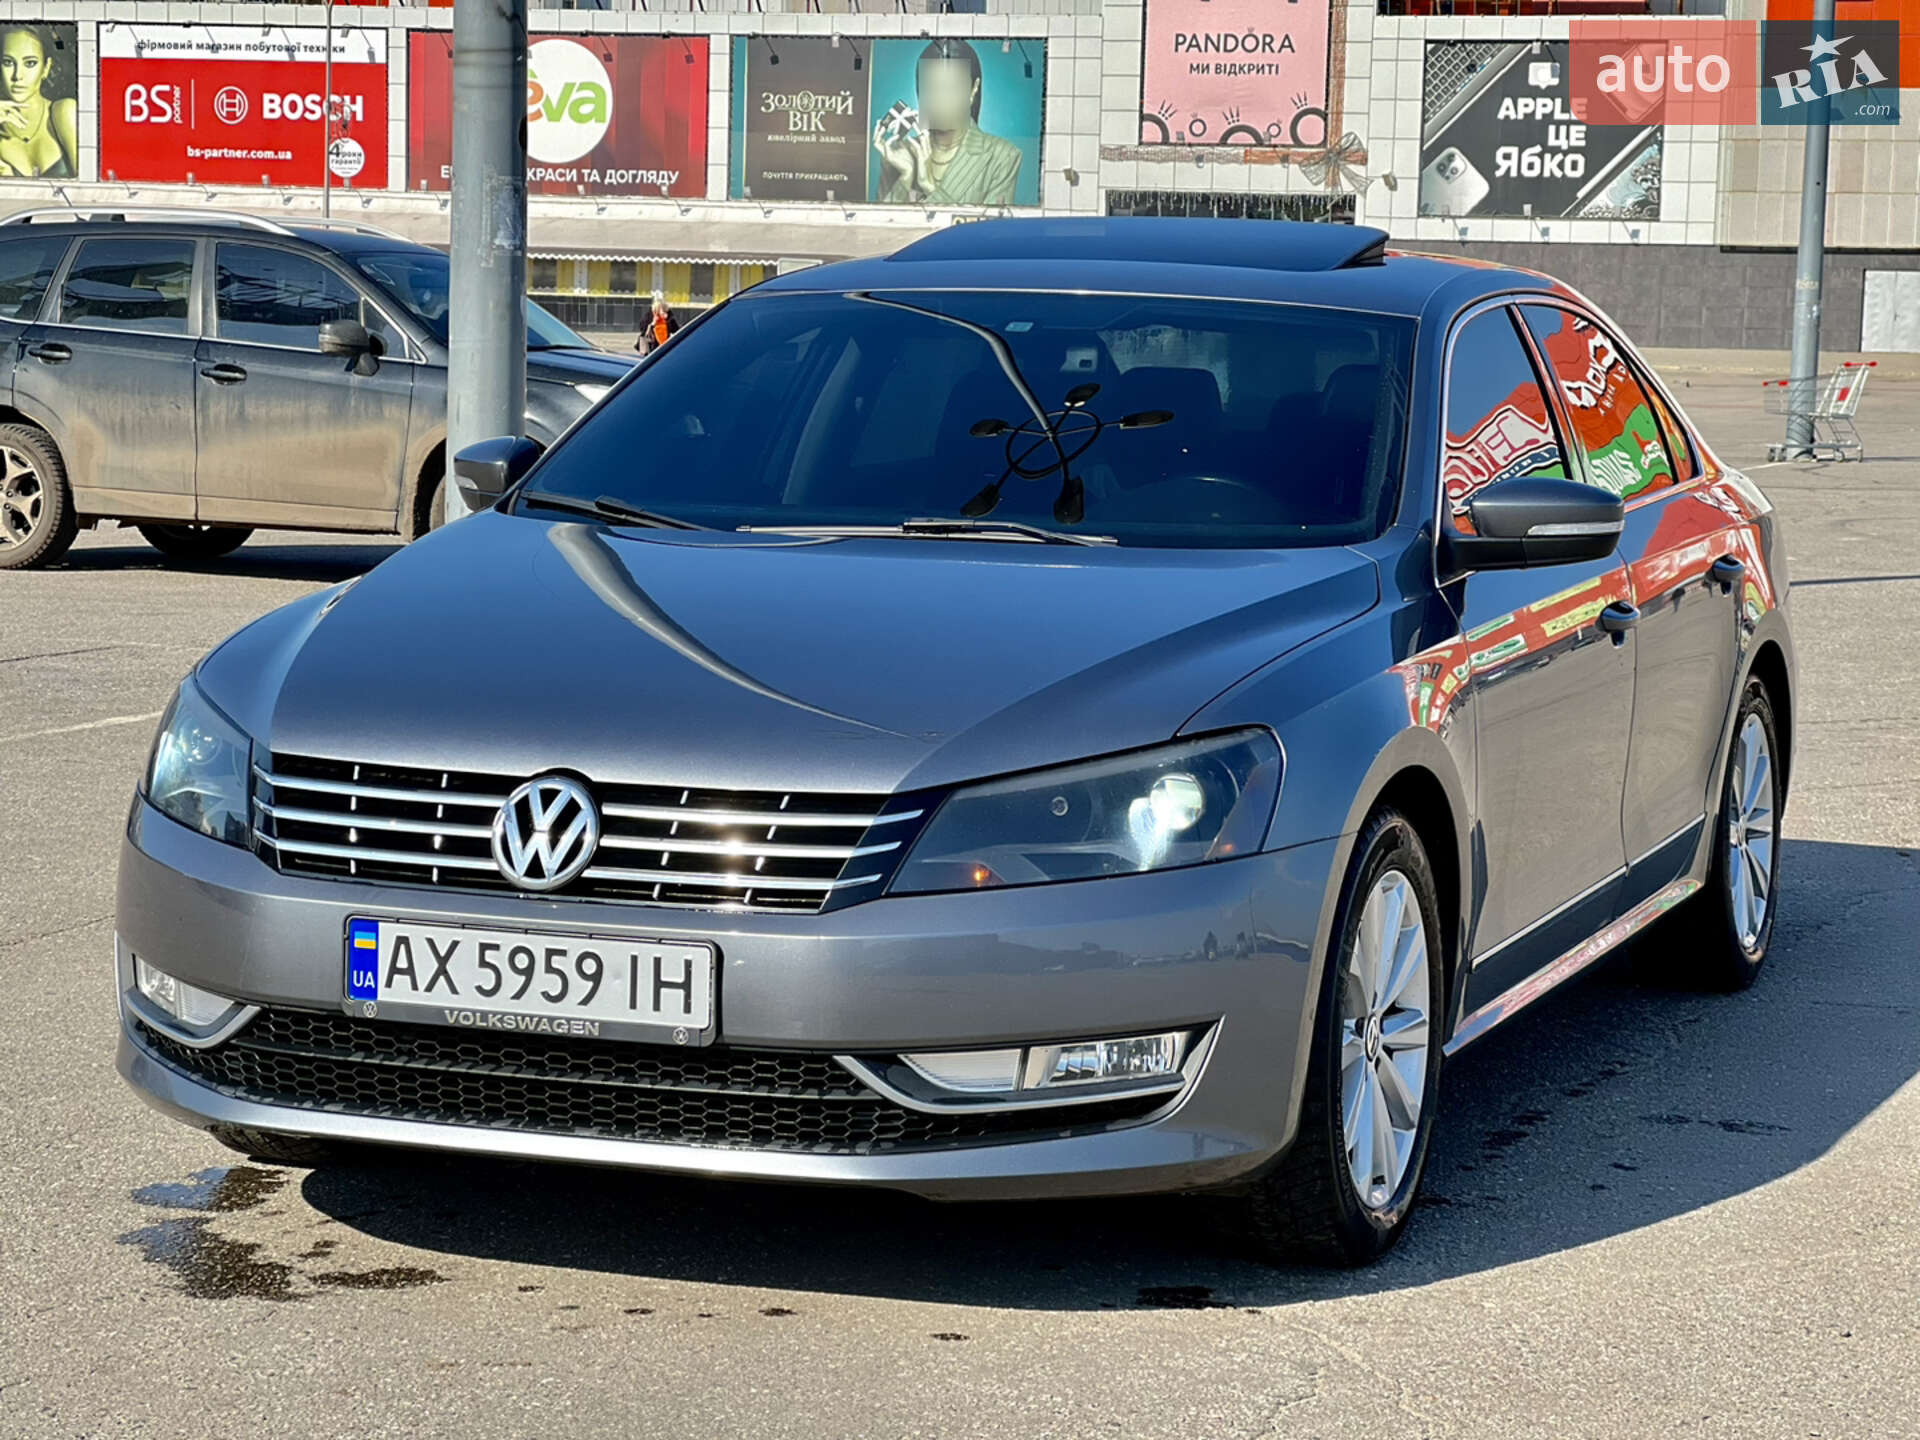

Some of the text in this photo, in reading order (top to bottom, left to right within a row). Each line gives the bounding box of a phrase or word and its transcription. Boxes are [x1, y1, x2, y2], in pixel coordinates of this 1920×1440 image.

[137, 39, 345, 54] фірмовий магазин побутової технки
[1174, 33, 1296, 53] PANDORA
[1189, 63, 1280, 76] МИ ВІДКРИТІ
[125, 83, 173, 123] BS
[262, 93, 364, 122] BOSCH
[1497, 97, 1588, 120] APPLE
[1547, 124, 1587, 150] ЦЕ
[186, 145, 292, 160] bs-partner.com.ua
[527, 168, 680, 186] КРАСИ ТА ДОГЛЯДУ
[352, 969, 375, 989] UA
[384, 935, 693, 1014] AX 5959 IH
[444, 1010, 600, 1036] VOLKSWAGEN
